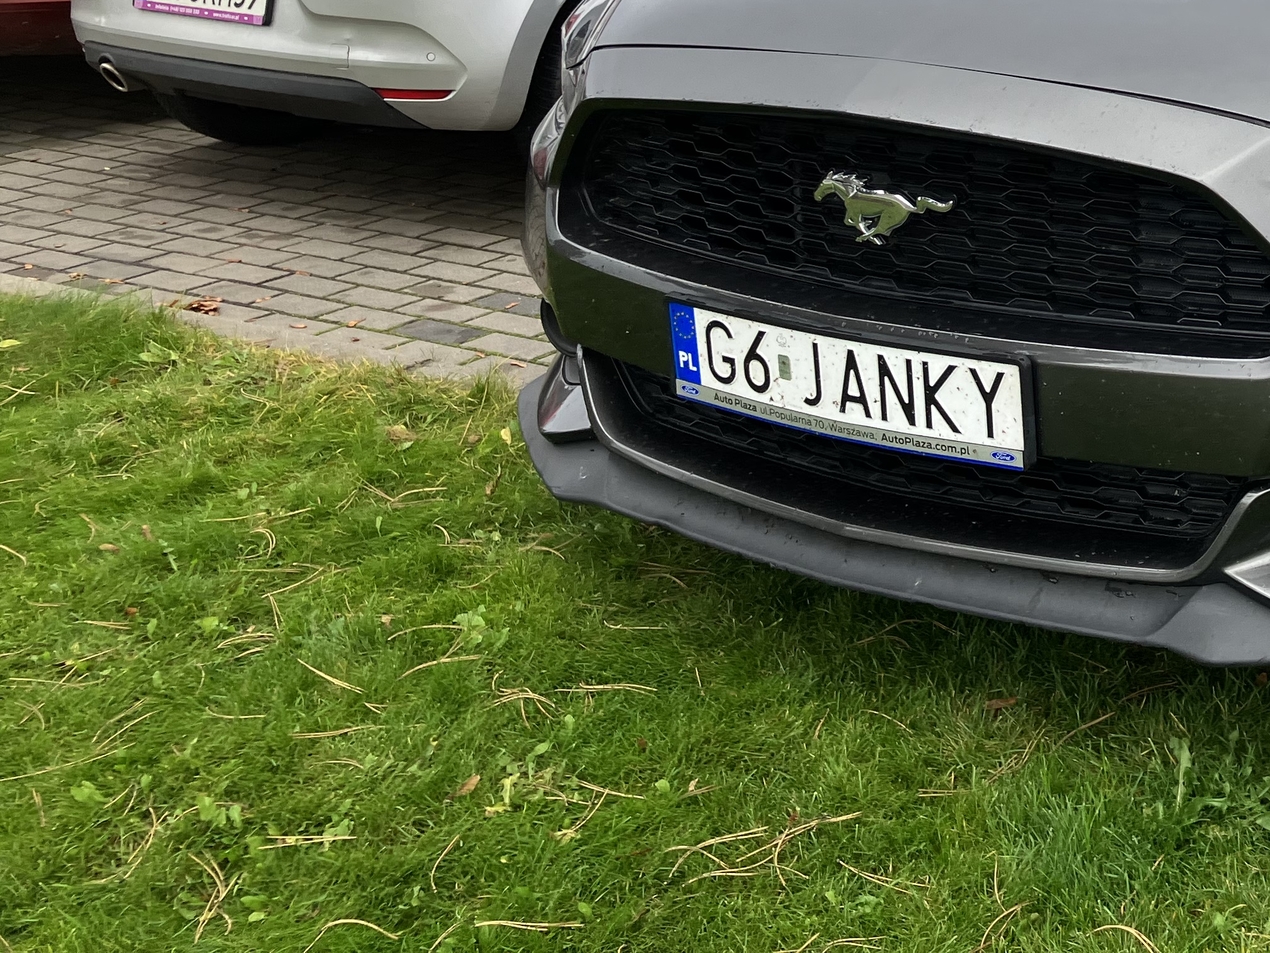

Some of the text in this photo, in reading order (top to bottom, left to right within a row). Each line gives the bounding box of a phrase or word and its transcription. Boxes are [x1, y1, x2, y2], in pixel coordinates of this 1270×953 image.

[678, 350, 698, 372] PL
[705, 319, 1006, 439] G6 JANKY
[713, 393, 733, 406] Auto
[734, 398, 758, 413] Plaza
[880, 432, 971, 456] AutoPlaza.com.pl
